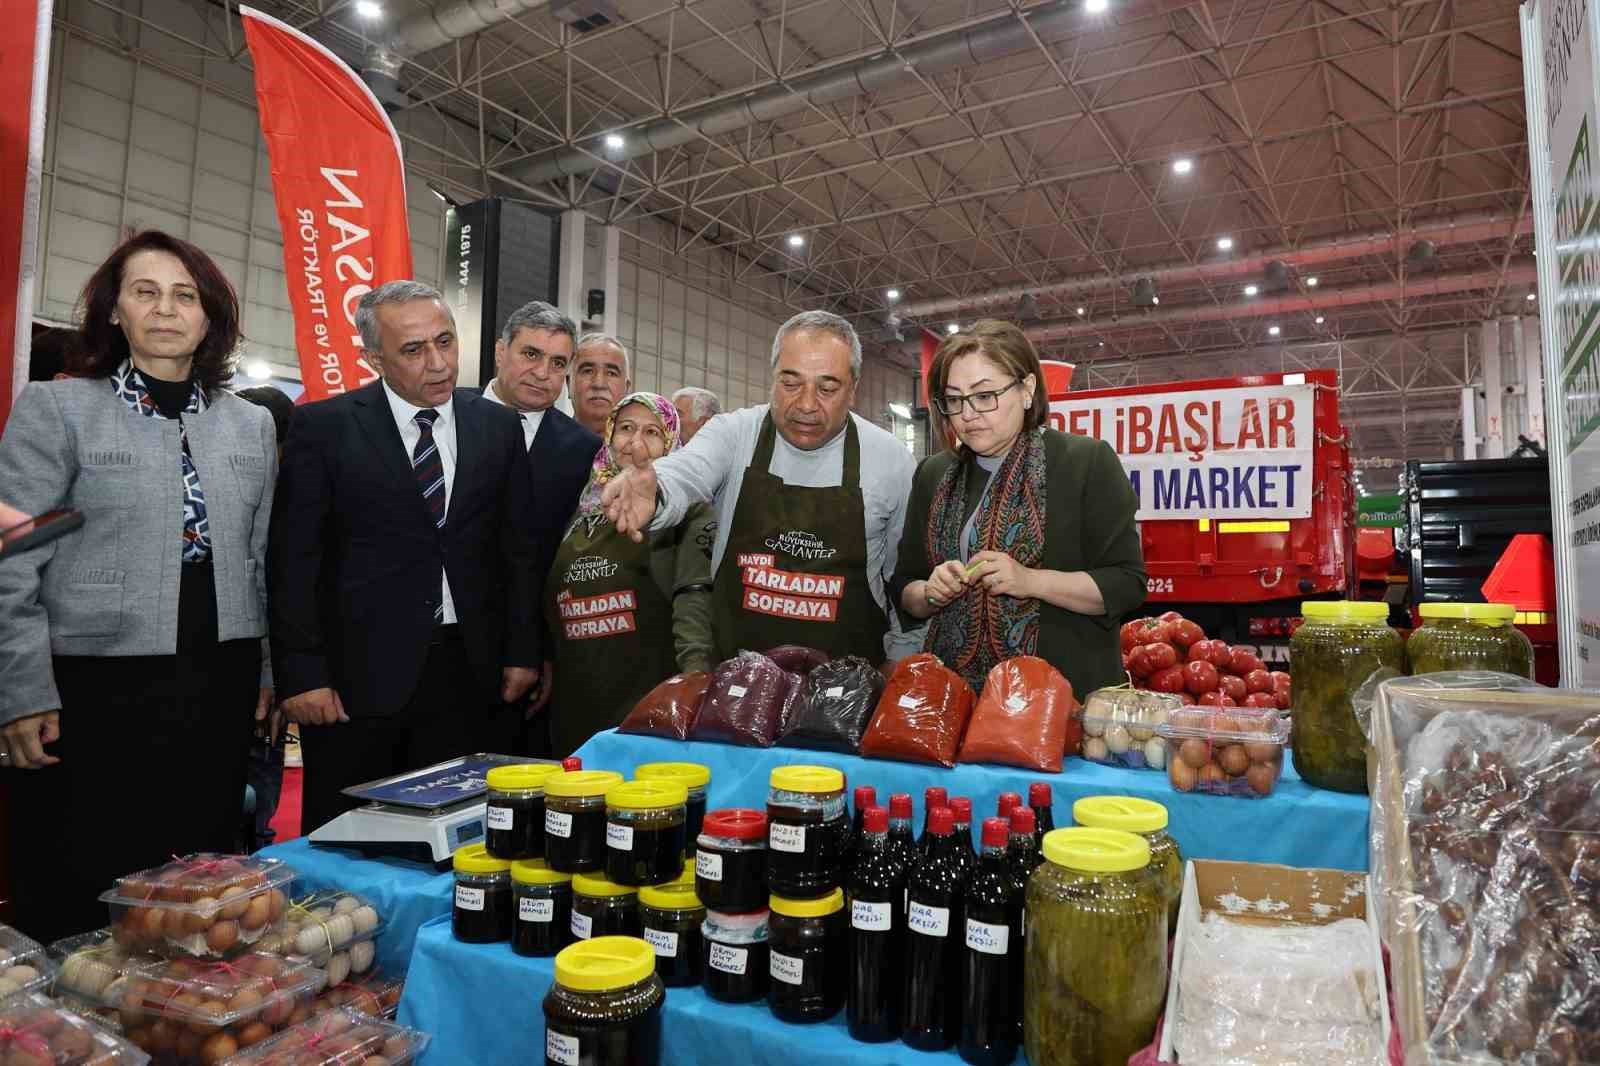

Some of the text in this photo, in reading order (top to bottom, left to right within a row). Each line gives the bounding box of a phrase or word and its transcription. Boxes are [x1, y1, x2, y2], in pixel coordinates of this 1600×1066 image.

[459, 260, 470, 286] 444
[1153, 464, 1302, 511] MARKET
[747, 567, 841, 596] TARLADAN
[560, 593, 633, 617] TARLADAN
[748, 591, 831, 618] SOFRAYA
[566, 615, 630, 638] SOFRAYA
